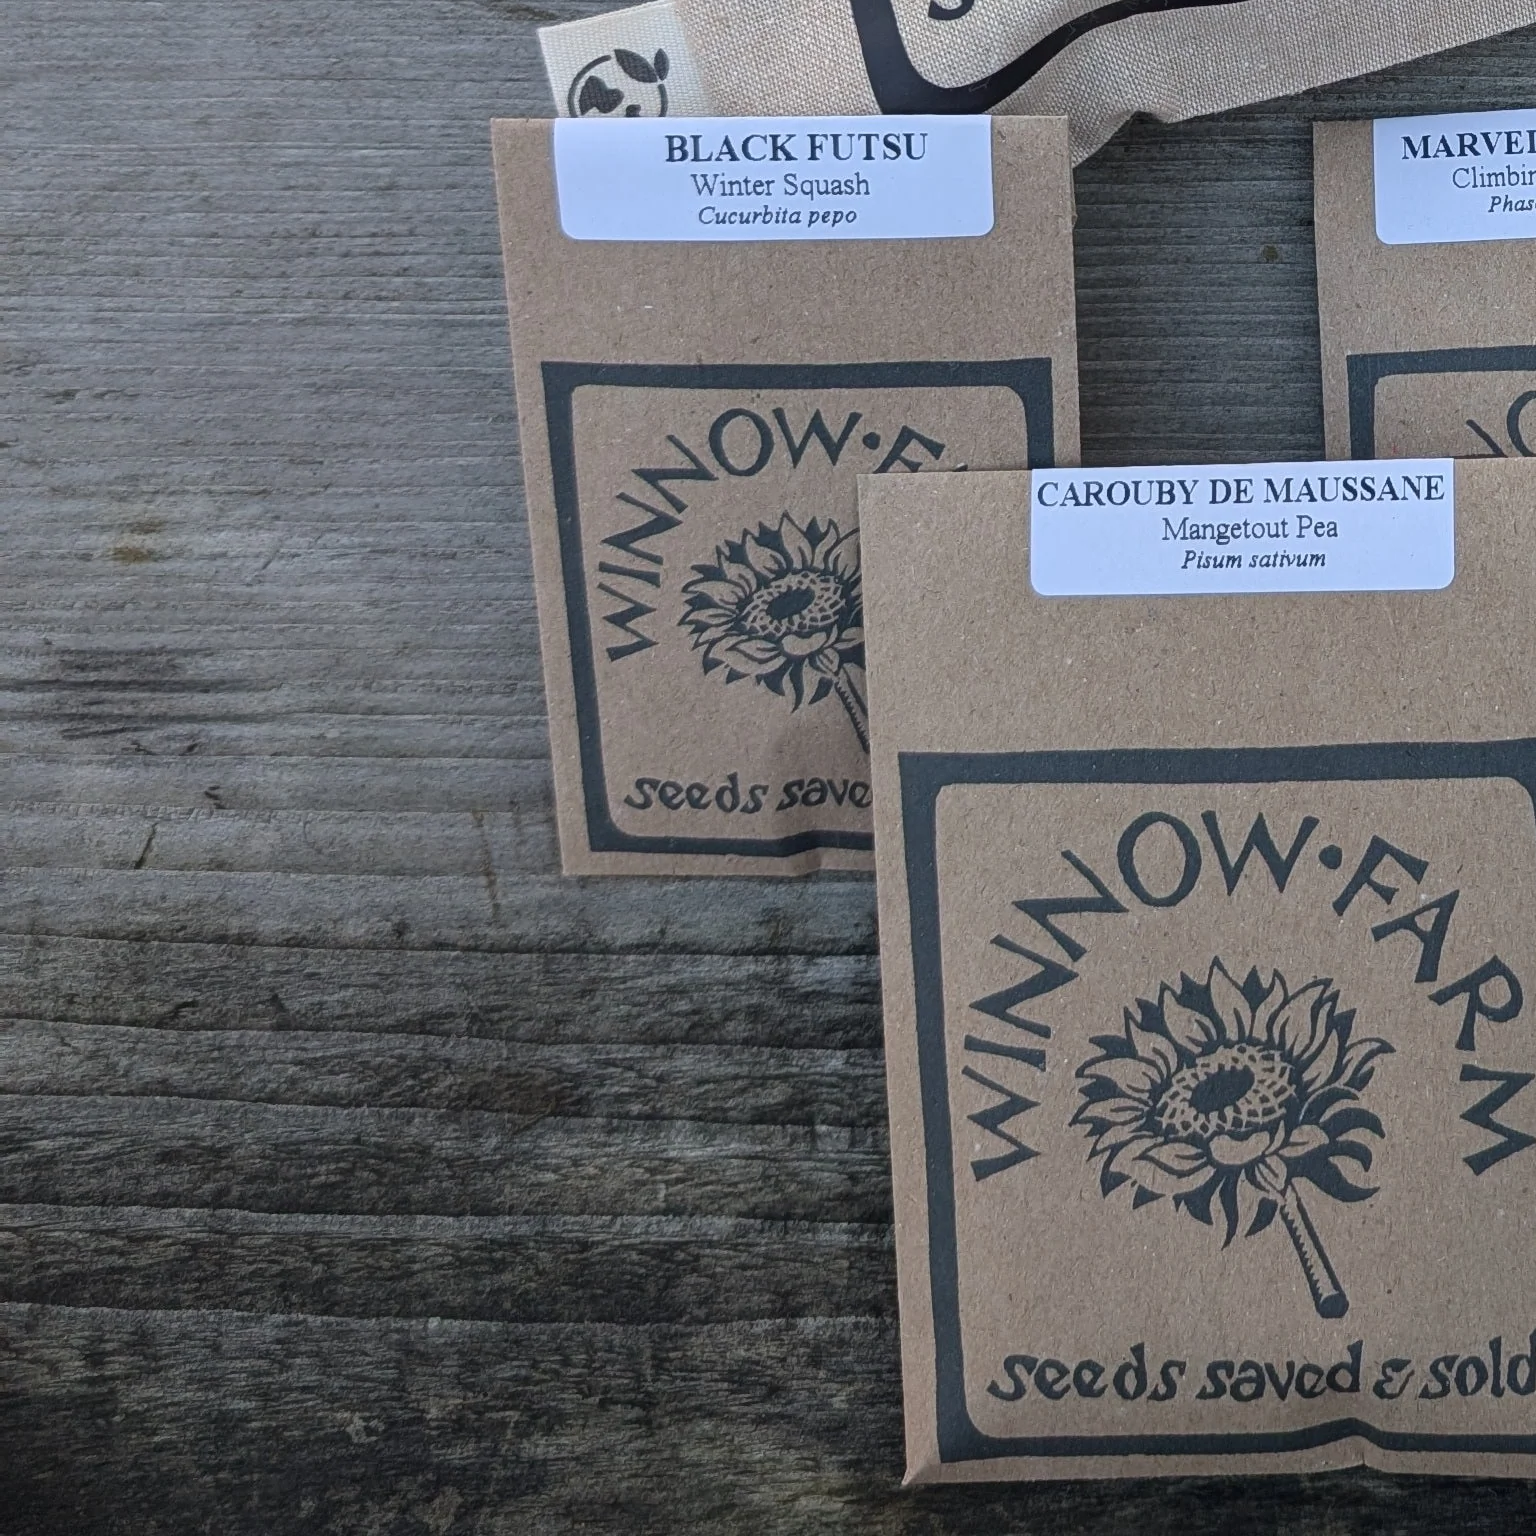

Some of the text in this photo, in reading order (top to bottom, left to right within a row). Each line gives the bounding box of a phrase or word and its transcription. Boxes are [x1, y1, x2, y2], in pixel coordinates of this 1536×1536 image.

[665, 132, 928, 162] BLACK FUTSU
[690, 172, 871, 201] Winter Squash
[698, 205, 858, 228] Cucurbita pepo
[1037, 475, 1446, 507] CAROUBY DE MAUSSANE
[1161, 515, 1339, 544] Mangetout Pea
[1180, 550, 1327, 570] Pisum sativum
[624, 772, 873, 814] seeds save
[987, 1341, 1188, 1402] seeds
[1197, 1339, 1363, 1401] saved
[1373, 1356, 1412, 1400] &
